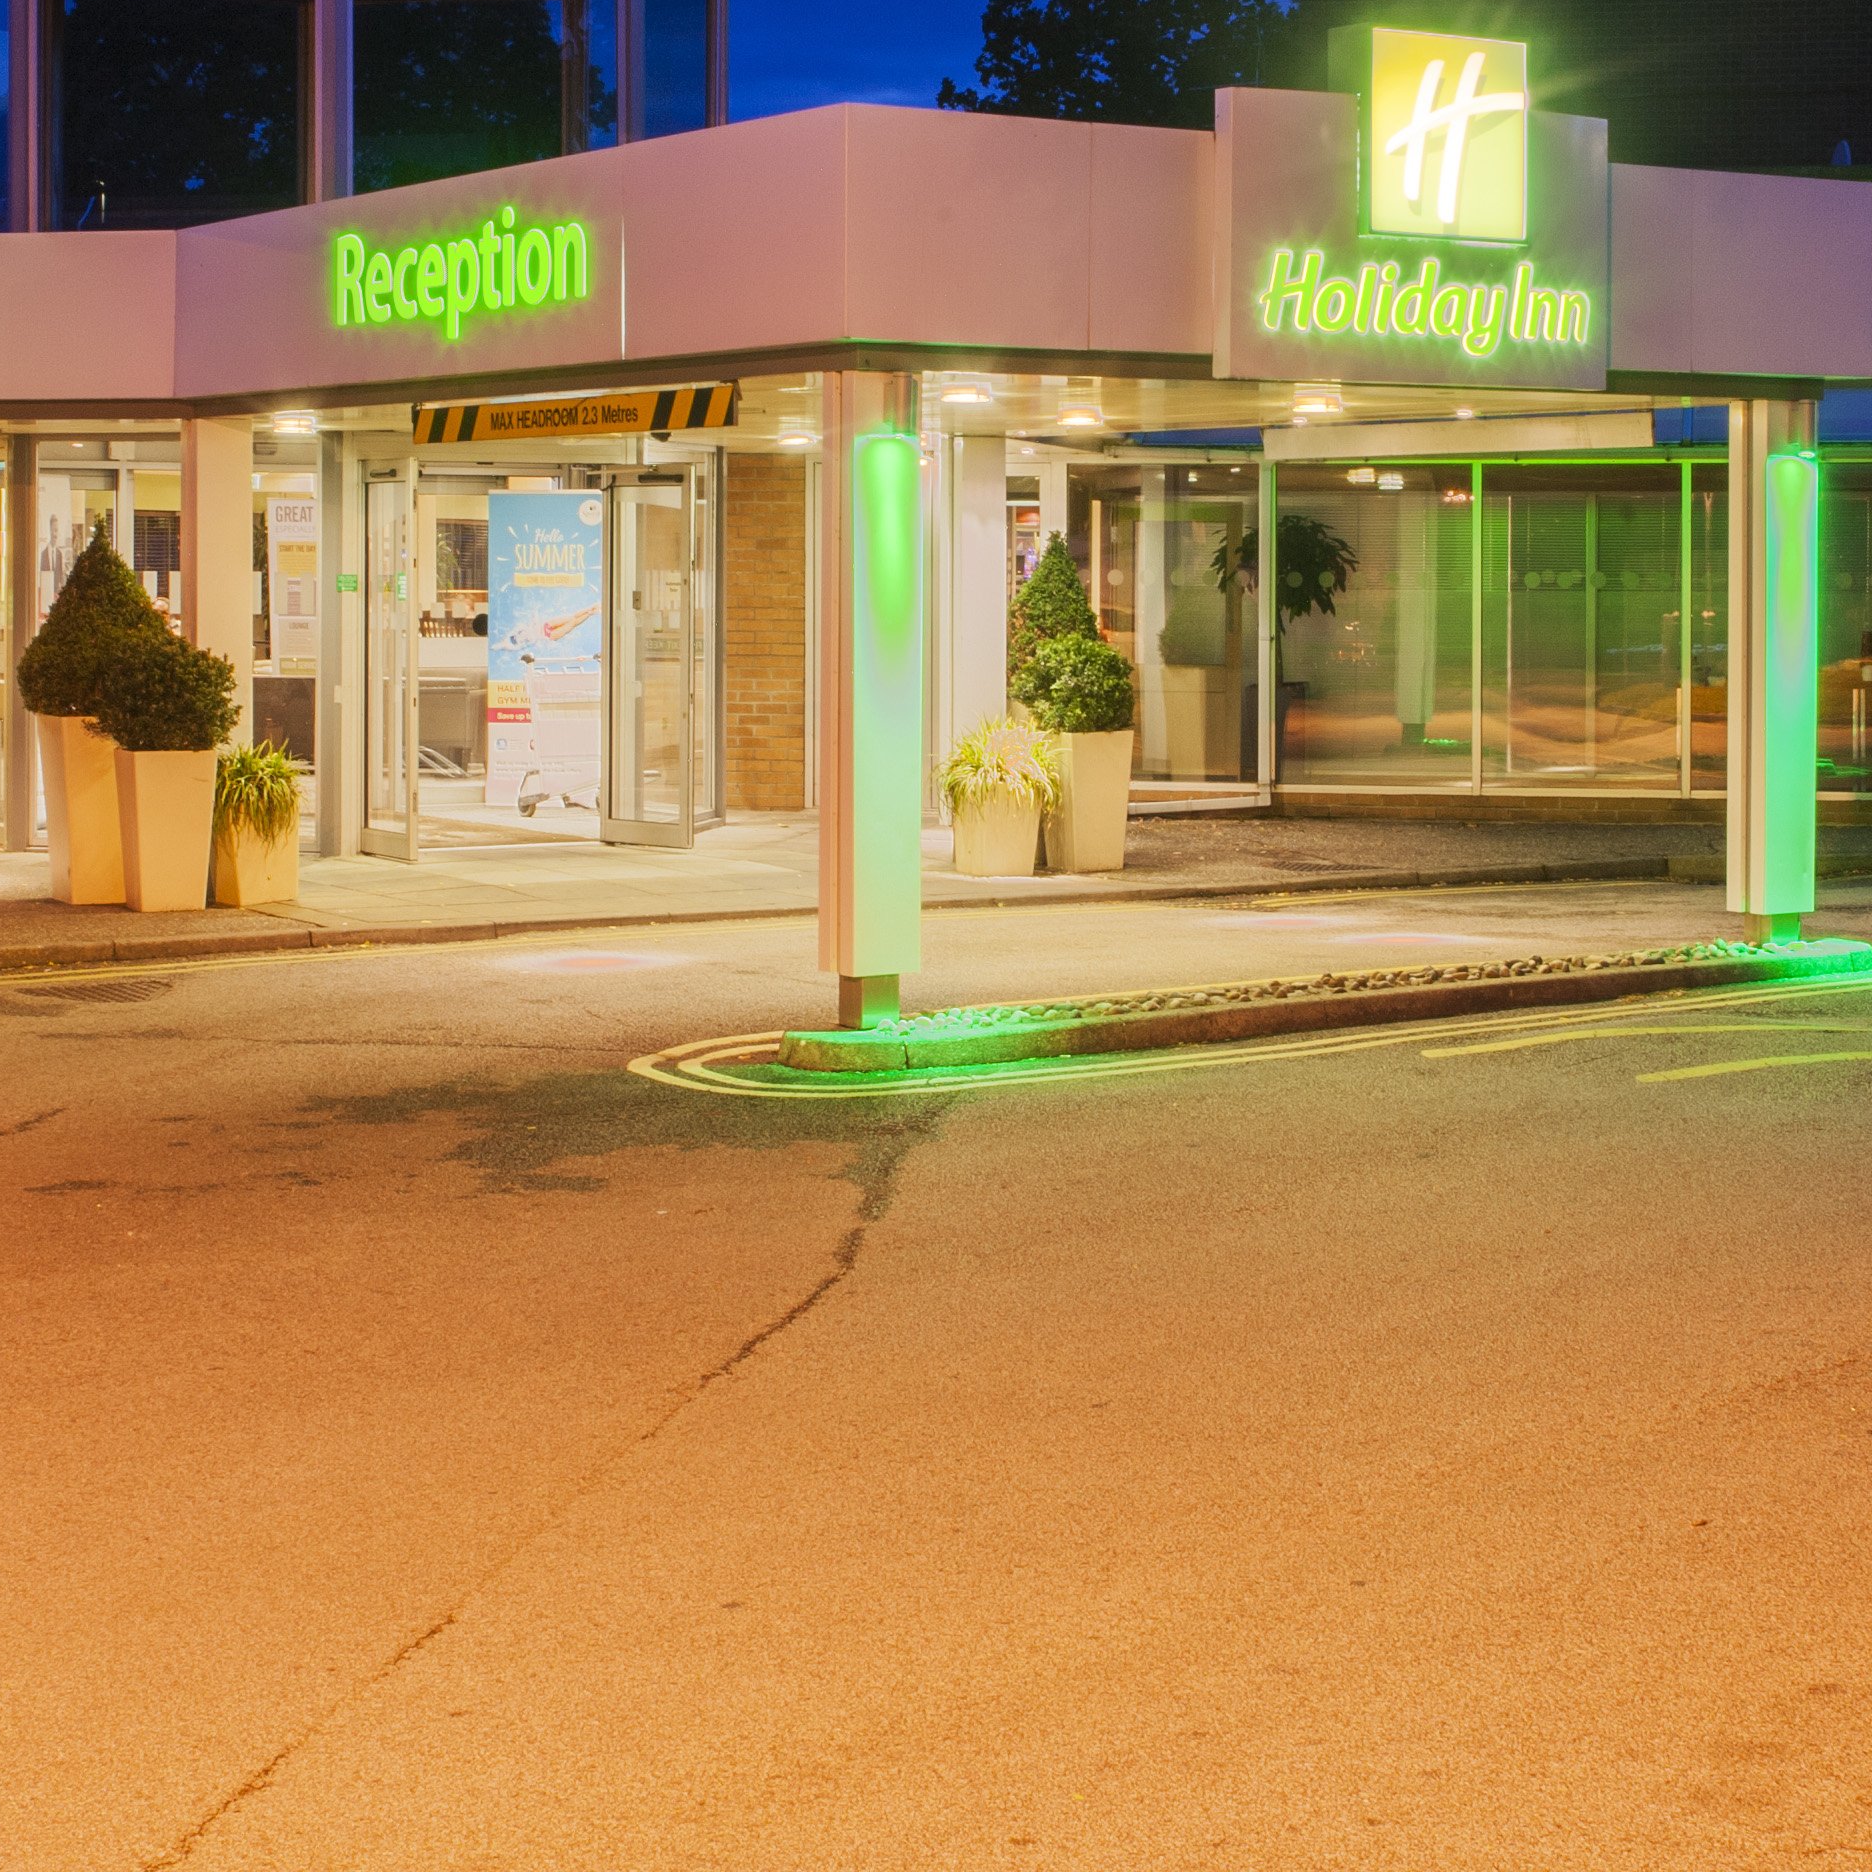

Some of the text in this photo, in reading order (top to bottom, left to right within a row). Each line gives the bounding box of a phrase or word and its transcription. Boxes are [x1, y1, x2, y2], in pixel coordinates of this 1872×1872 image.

[336, 205, 587, 339] Reception
[1259, 250, 1592, 359] Holiday Inn
[490, 404, 639, 431] MAX HEADROOM 2.3 Metres
[275, 505, 314, 523] GREAT
[534, 528, 565, 544] Hello
[514, 543, 585, 571] SUMMER
[497, 684, 520, 693] HALF
[497, 696, 518, 705] GYM
